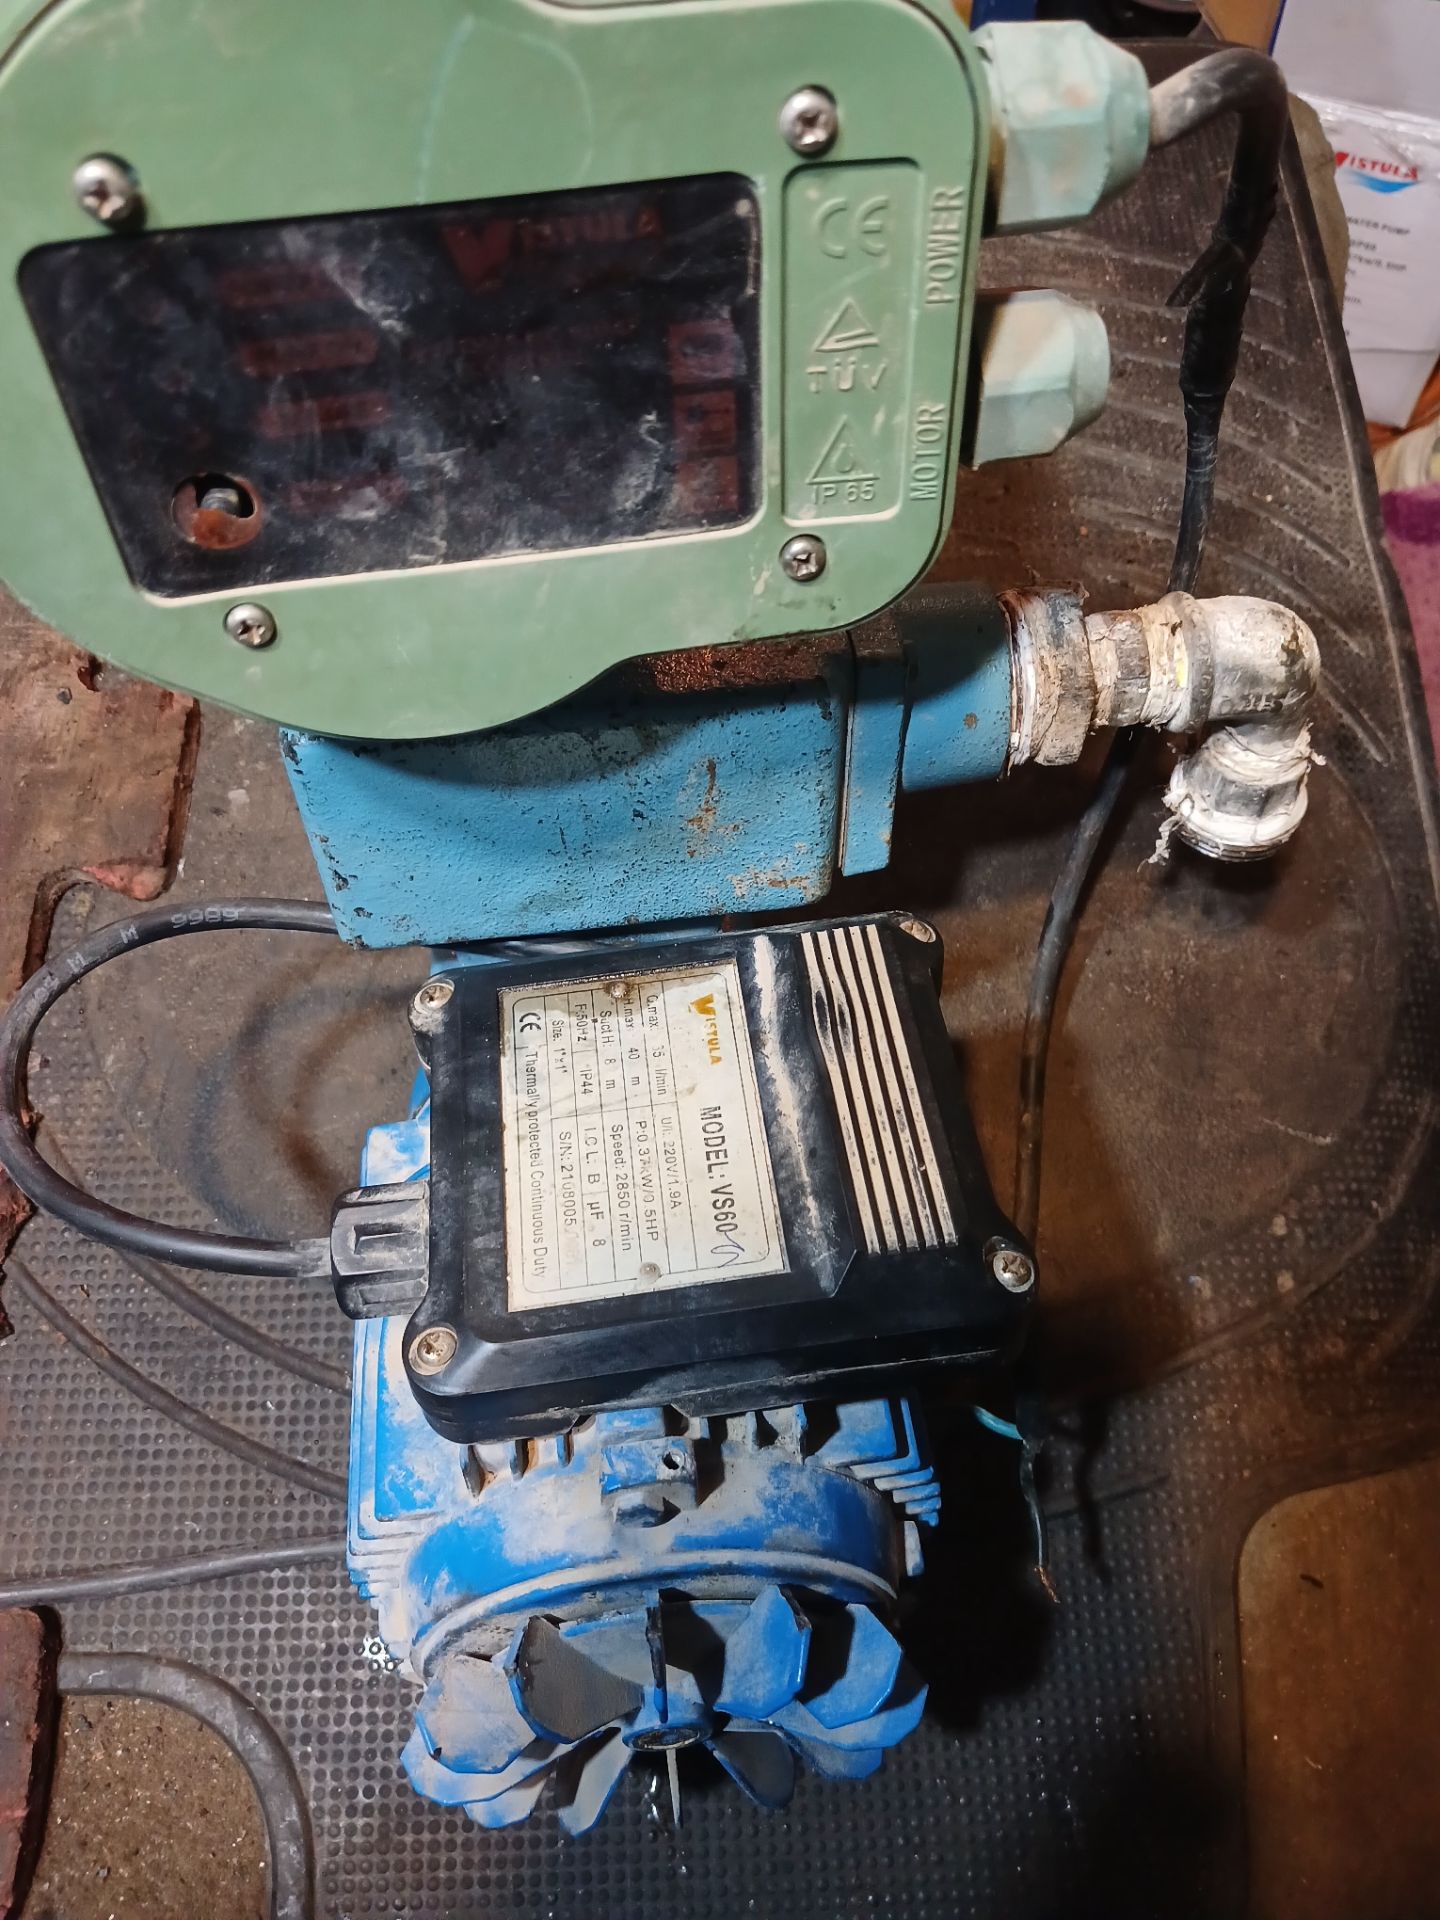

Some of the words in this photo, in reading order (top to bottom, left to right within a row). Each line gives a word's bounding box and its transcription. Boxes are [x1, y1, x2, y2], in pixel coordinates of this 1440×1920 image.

[925, 185, 964, 305] POWER
[805, 358, 888, 393] TÜV
[910, 403, 946, 501] MOTOR
[845, 481, 876, 502] 65
[552, 1020, 564, 1041] Size:
[688, 994, 722, 1065] VISTULA
[524, 1052, 540, 1108] Thermally
[580, 1069, 593, 1095] IP44
[606, 1080, 615, 1089] m
[631, 1077, 640, 1085] m
[528, 1111, 544, 1167] protected
[559, 1132, 572, 1160] S/N:
[610, 1125, 626, 1169] Speed:
[700, 1106, 727, 1179] MODEL:
[588, 1174, 600, 1184] B
[616, 1173, 630, 1208] 2850
[664, 1141, 682, 1210] 220V/1.9A
[531, 1170, 546, 1242] Continuous
[587, 1202, 604, 1220] µF
[710, 1185, 738, 1233] VS60
[619, 1213, 632, 1251] r/min
[532, 1246, 548, 1278] Duty
